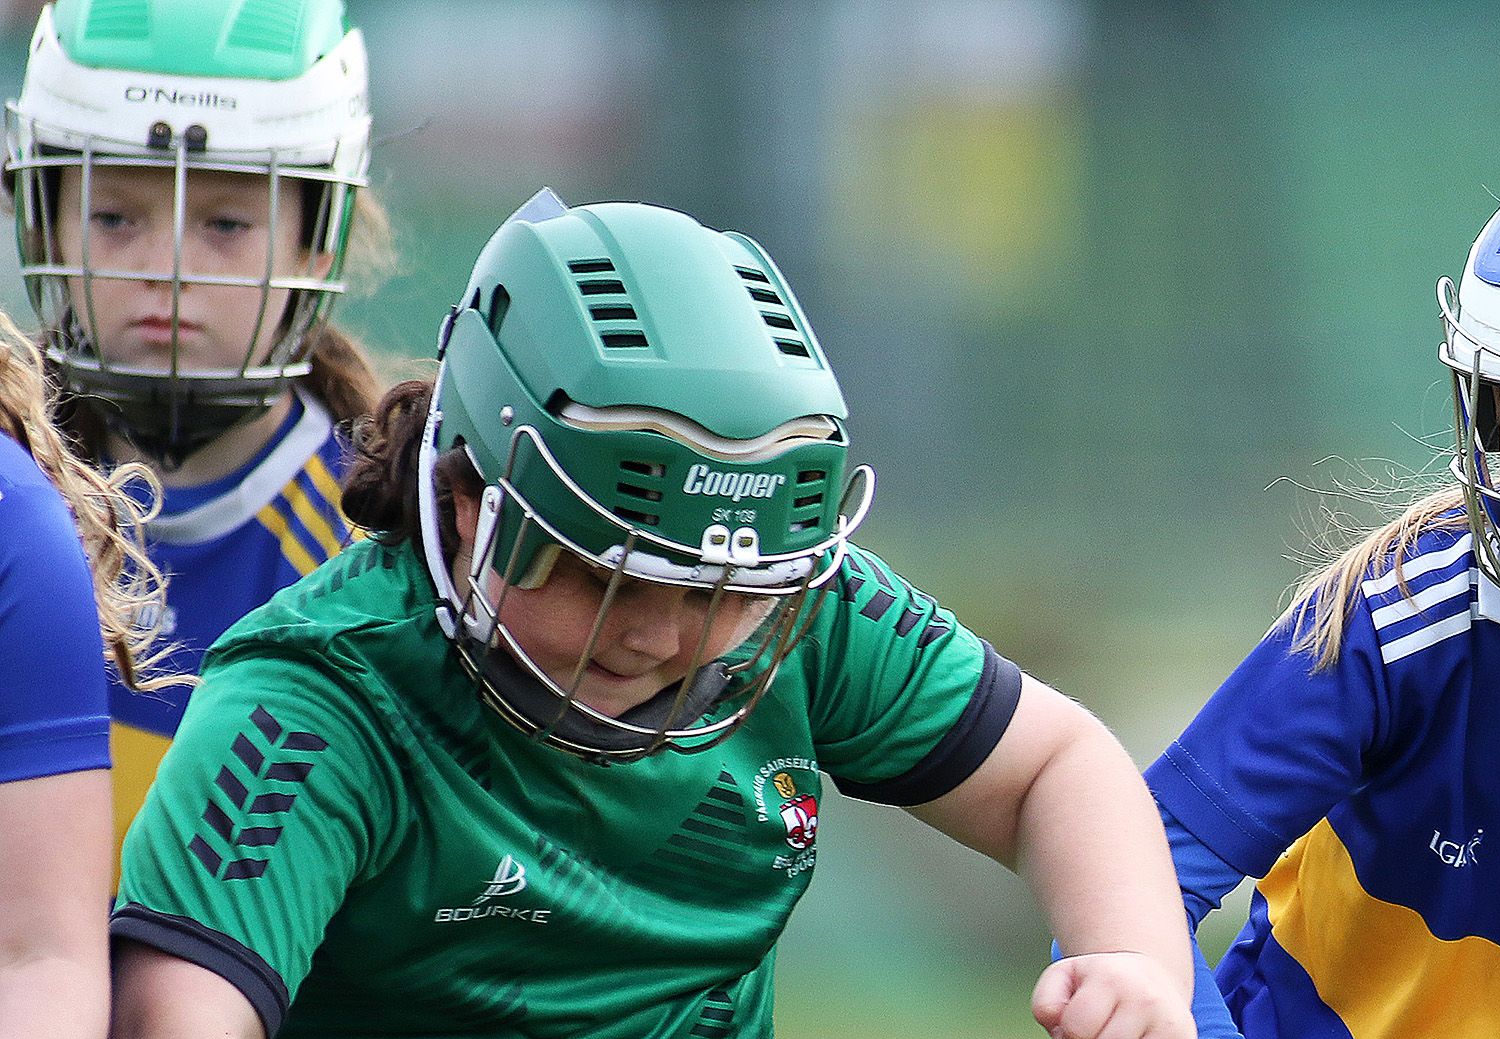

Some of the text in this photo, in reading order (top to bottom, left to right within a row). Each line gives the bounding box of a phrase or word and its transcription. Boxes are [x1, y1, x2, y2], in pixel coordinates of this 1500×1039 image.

[125, 86, 238, 110] O'Neills
[683, 464, 786, 502] Cooper
[434, 905, 552, 924] BOURKE
